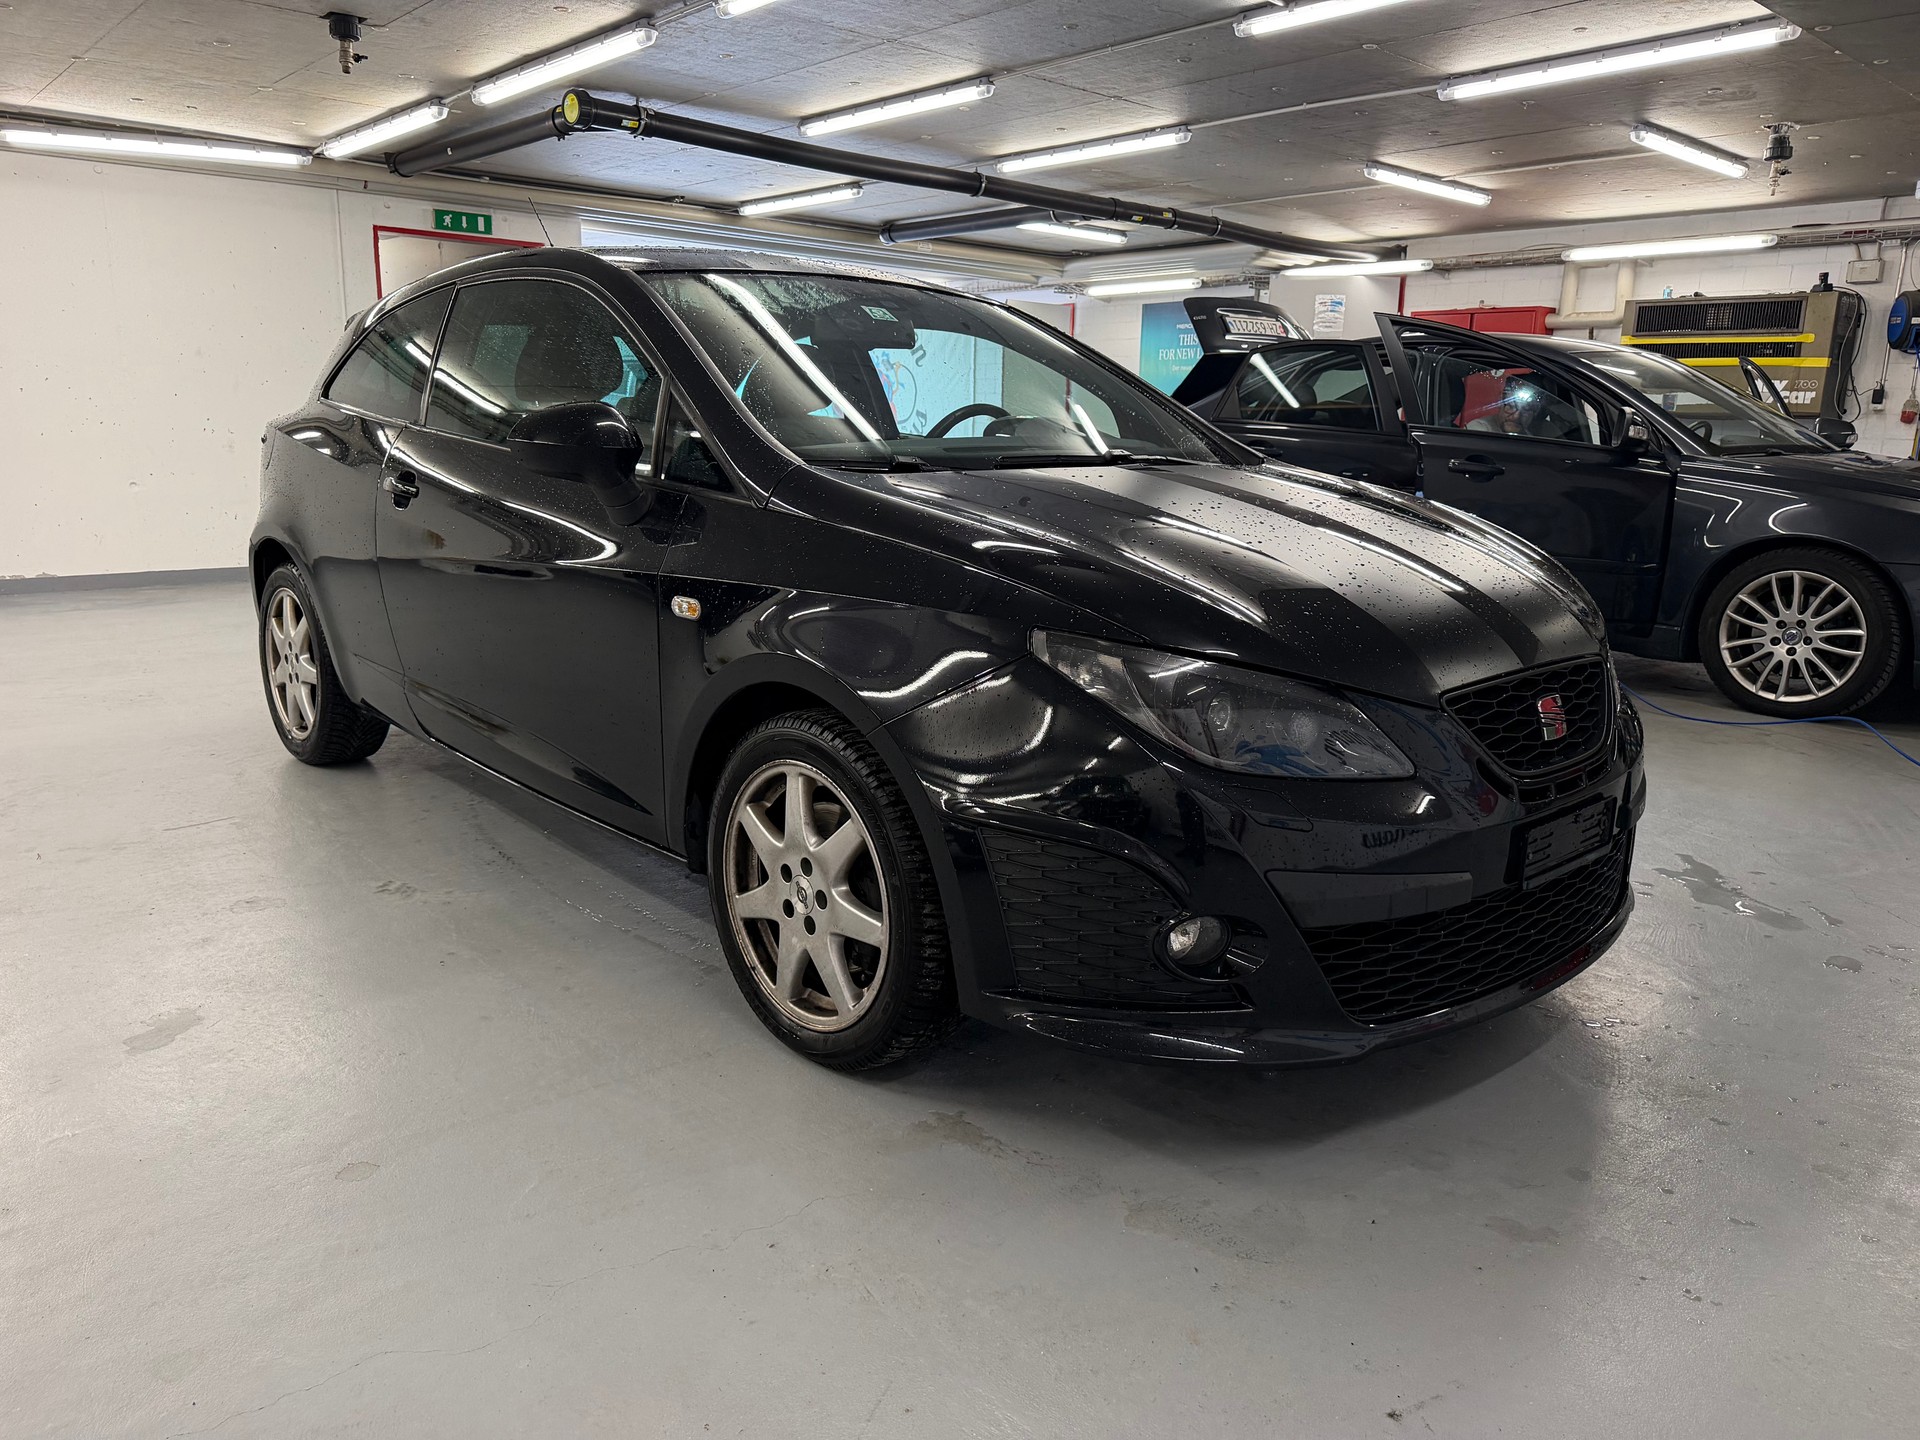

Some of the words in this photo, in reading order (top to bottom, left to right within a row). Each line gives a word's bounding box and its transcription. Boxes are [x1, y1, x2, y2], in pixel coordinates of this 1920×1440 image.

[1178, 333, 1199, 346] THIS
[1159, 349, 1175, 361] FOR
[1176, 347, 1196, 360] NEW
[1794, 379, 1819, 389] 700
